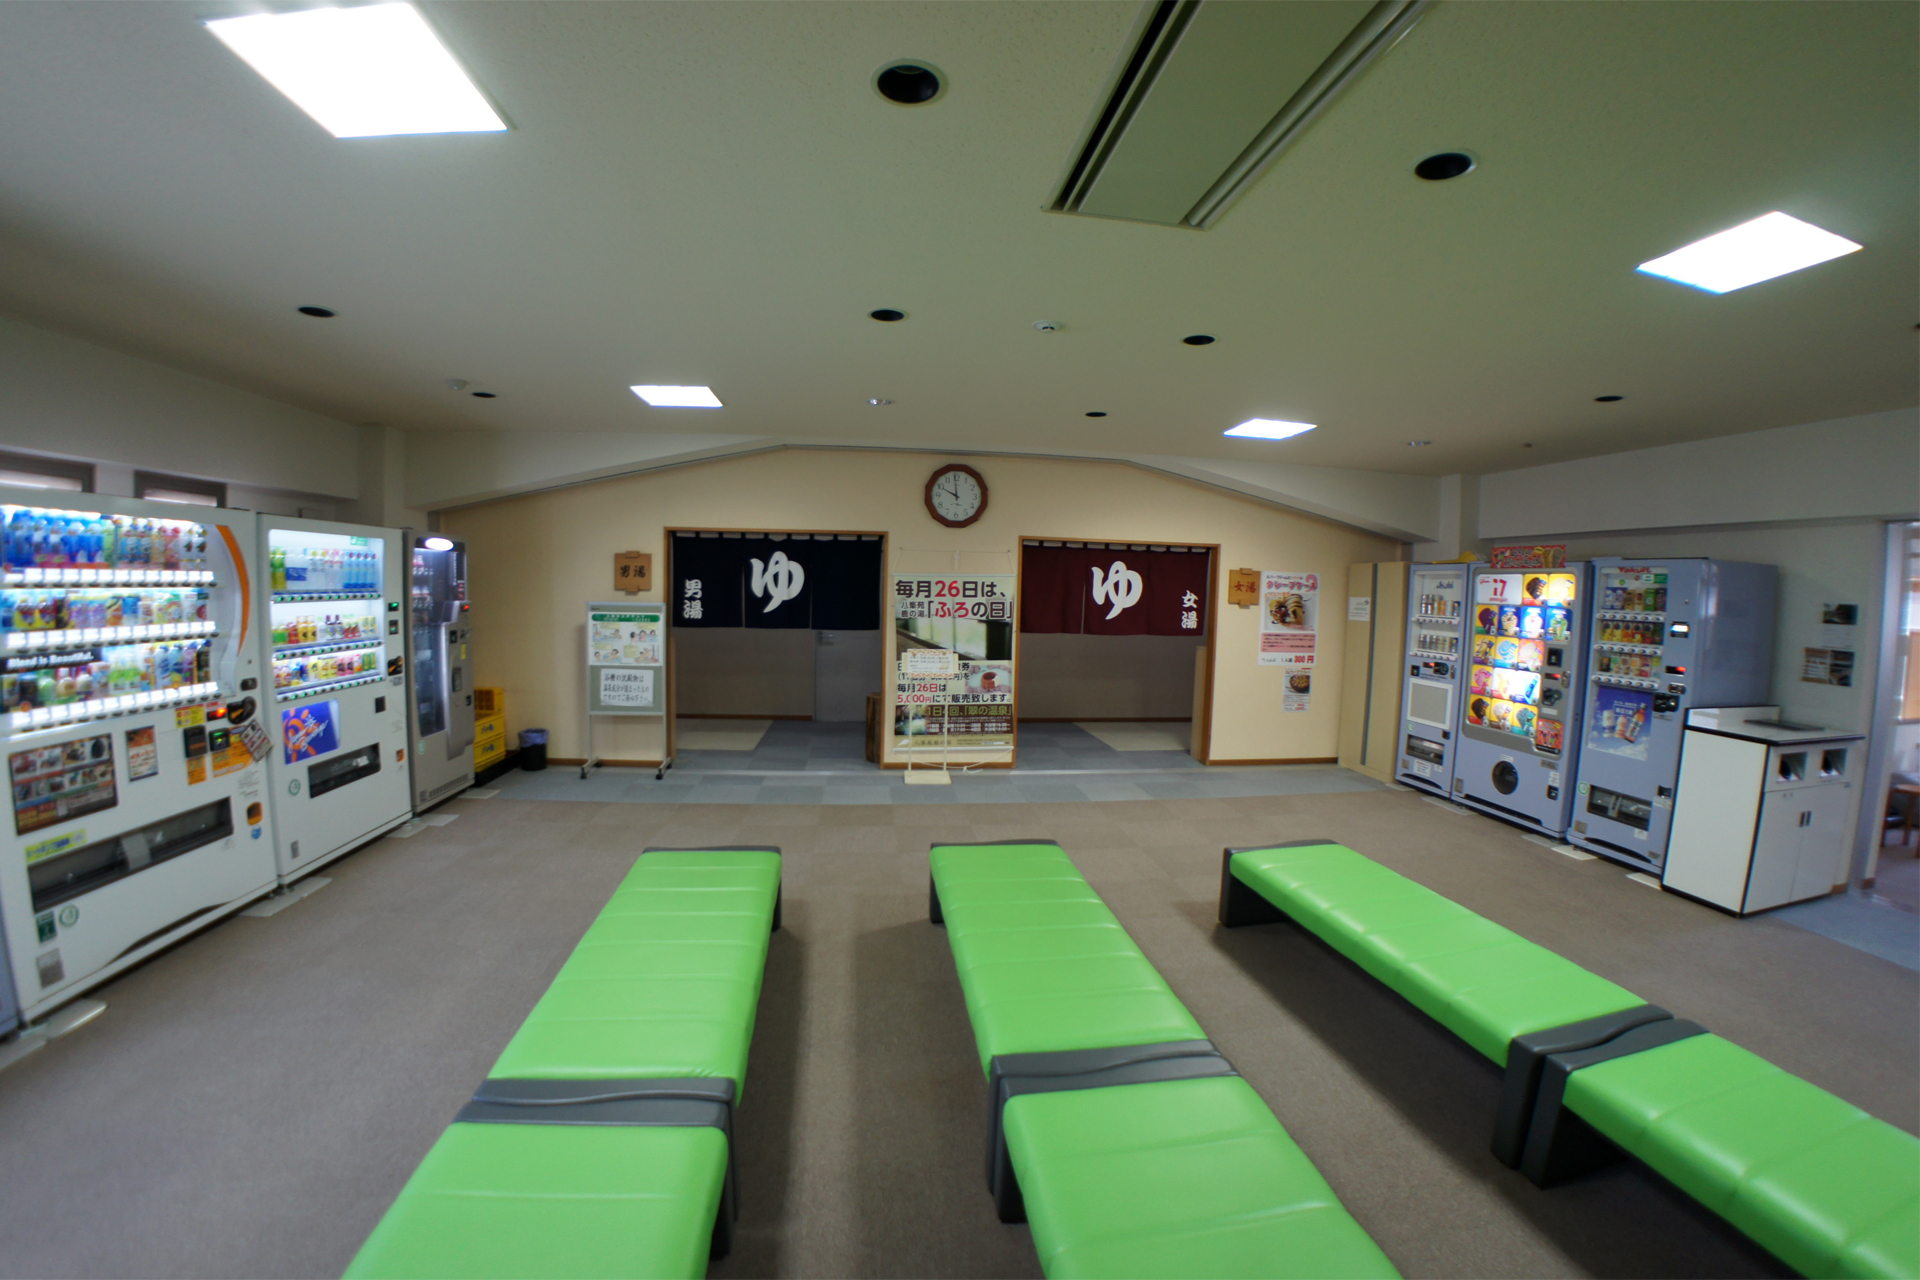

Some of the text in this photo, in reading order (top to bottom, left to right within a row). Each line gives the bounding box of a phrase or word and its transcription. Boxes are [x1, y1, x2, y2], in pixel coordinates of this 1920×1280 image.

[620, 564, 646, 578] 男湯
[749, 550, 805, 614] ゆ
[895, 579, 1006, 599] 毎月26日は、
[1090, 560, 1143, 620] ゆ
[1233, 580, 1257, 594] 女湯
[682, 578, 704, 620] 男湯
[1181, 589, 1199, 630] 女湯
